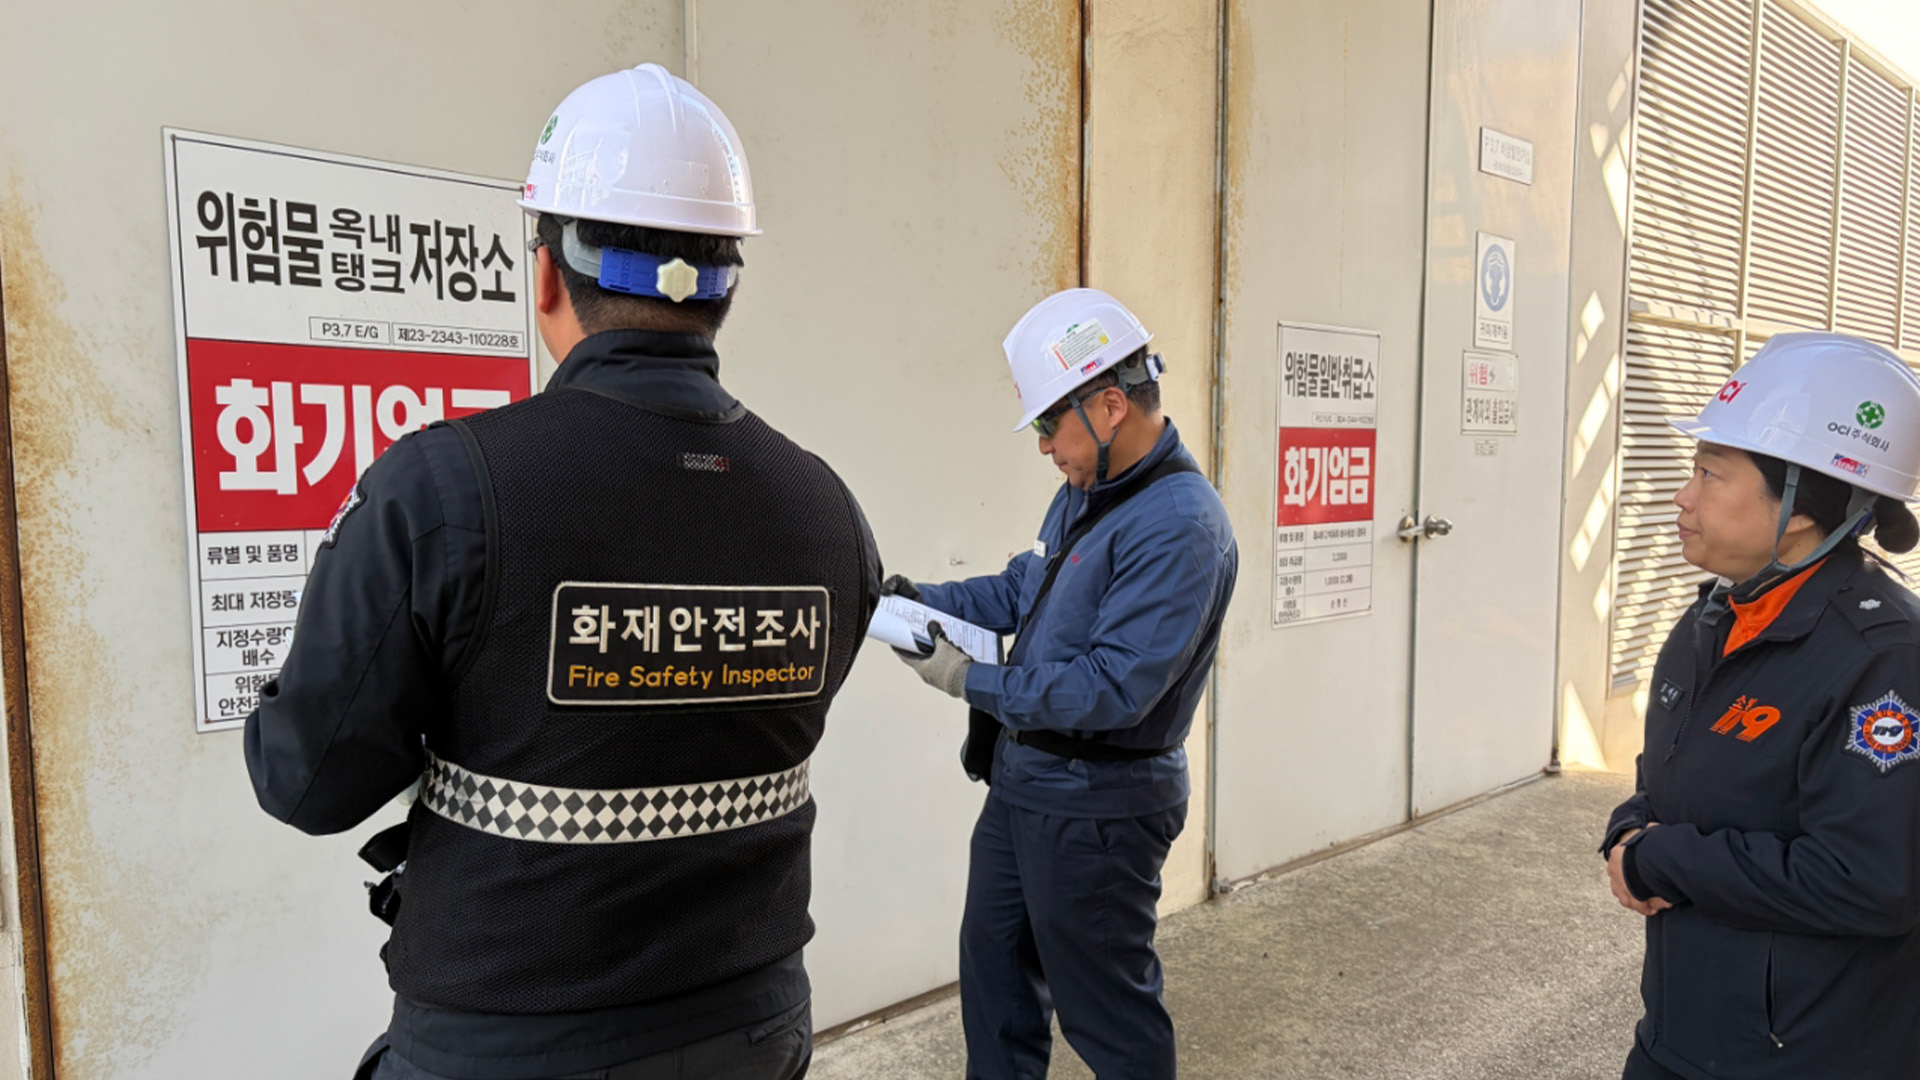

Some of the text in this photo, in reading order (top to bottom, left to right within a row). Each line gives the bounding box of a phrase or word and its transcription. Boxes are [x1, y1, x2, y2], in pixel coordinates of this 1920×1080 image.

[195, 190, 516, 302] 위험물 옥내 저장소
[331, 252, 406, 294] 탱크
[355, 324, 379, 340] E/G
[398, 326, 520, 348] 제23-2343-110228호
[1284, 350, 1375, 400] 위험물일반취급소
[1469, 363, 1488, 385] 위험
[1716, 379, 1747, 404] CI
[214, 377, 511, 496] 화기
[1827, 421, 1890, 453] OCI 주식회사
[1283, 446, 1371, 507] 화기엄금
[207, 543, 299, 565] 류별 및 품명
[211, 590, 298, 612] 최대 저장량
[568, 604, 821, 654] 화재안전조사
[242, 648, 275, 667] 배수
[568, 662, 816, 690] Fire Safety Inspector
